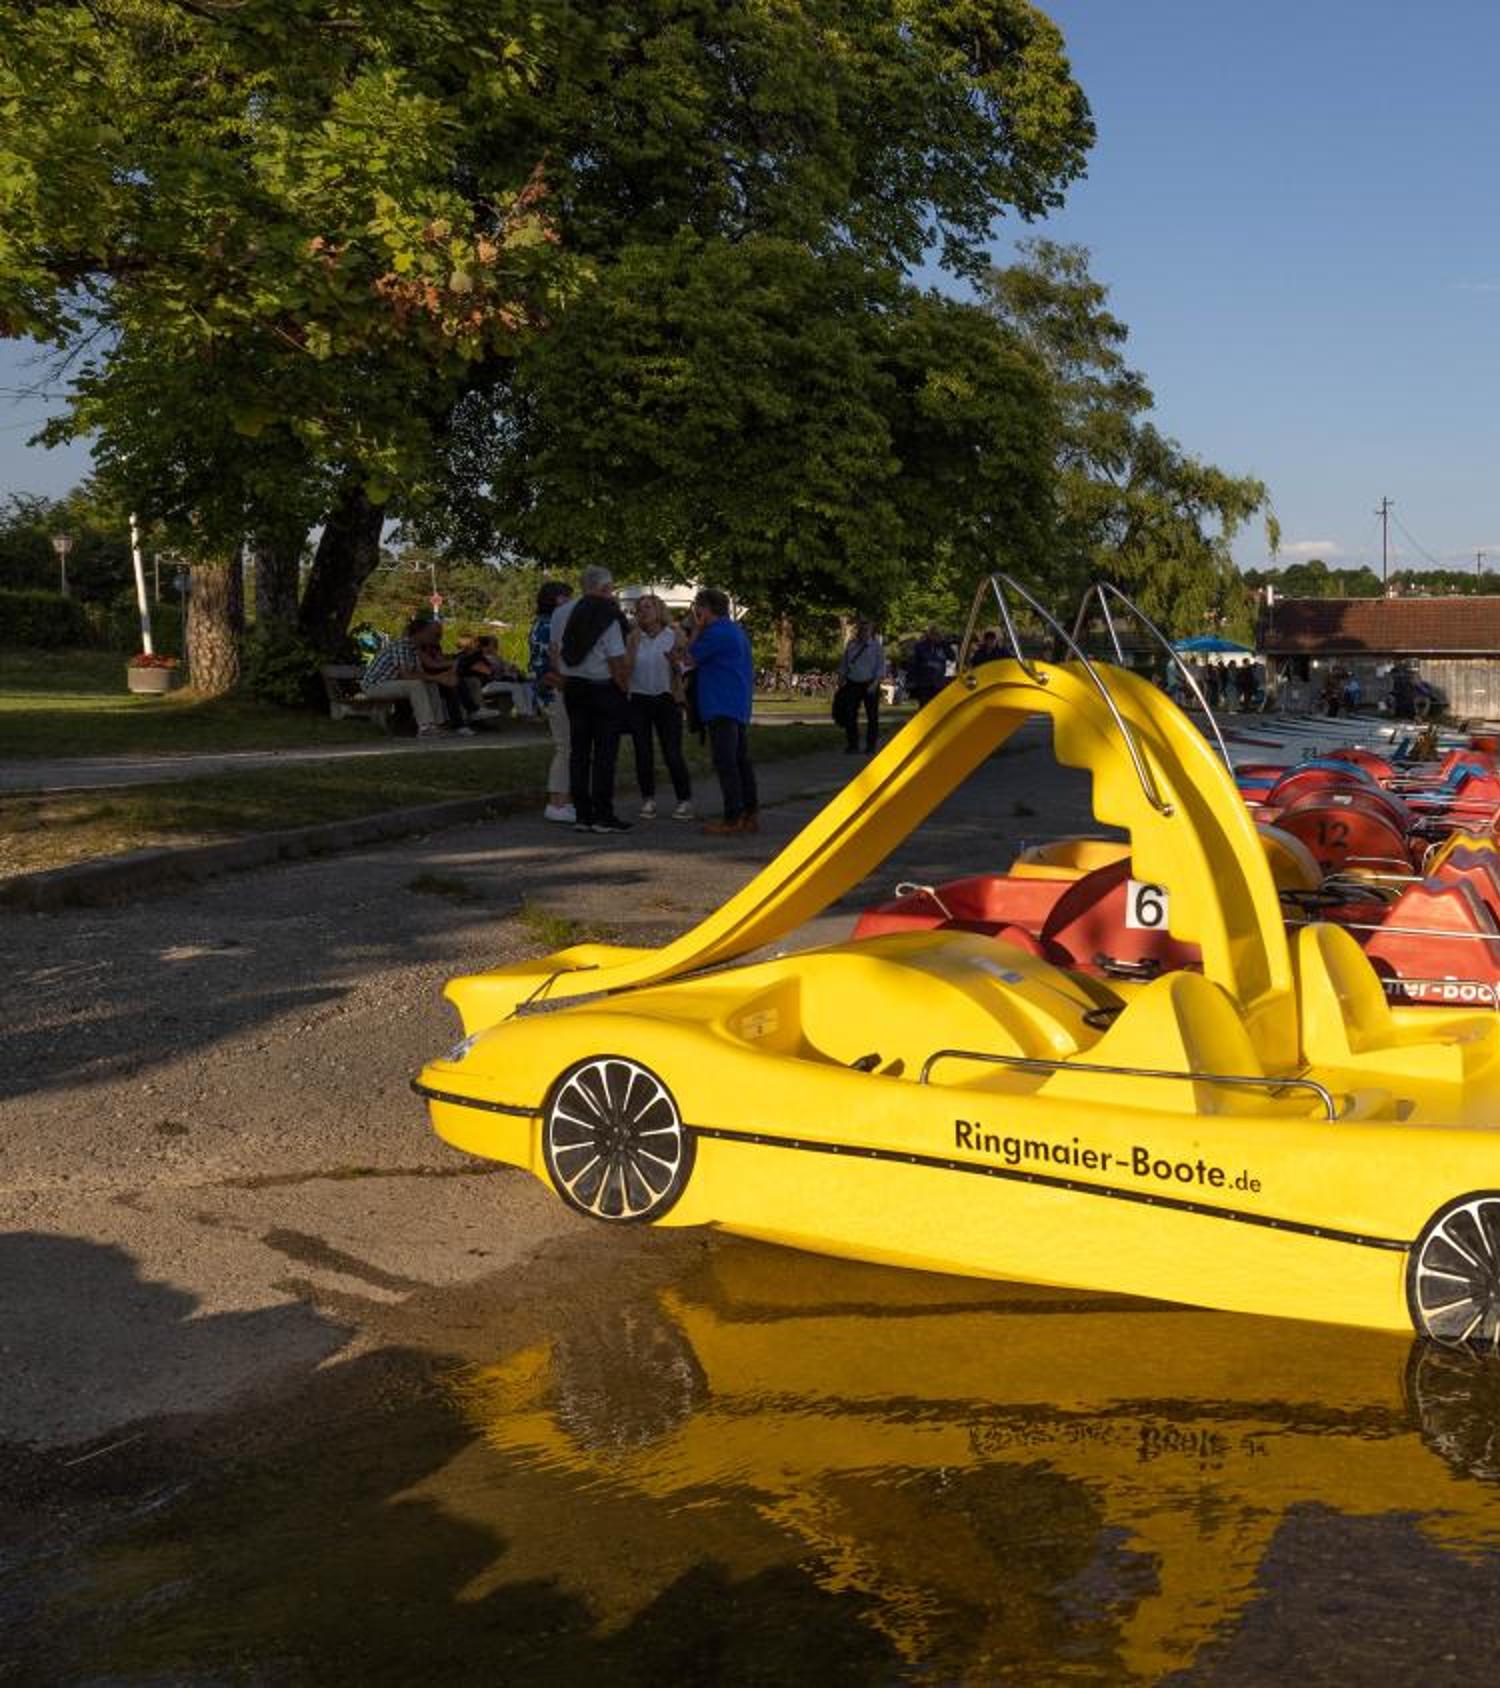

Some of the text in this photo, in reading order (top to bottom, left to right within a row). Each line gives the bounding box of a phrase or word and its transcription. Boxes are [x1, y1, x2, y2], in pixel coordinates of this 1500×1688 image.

[1316, 821, 1350, 848] 12
[1135, 884, 1164, 927] 6
[954, 1119, 1262, 1193] Ringmaier-Boote.de
